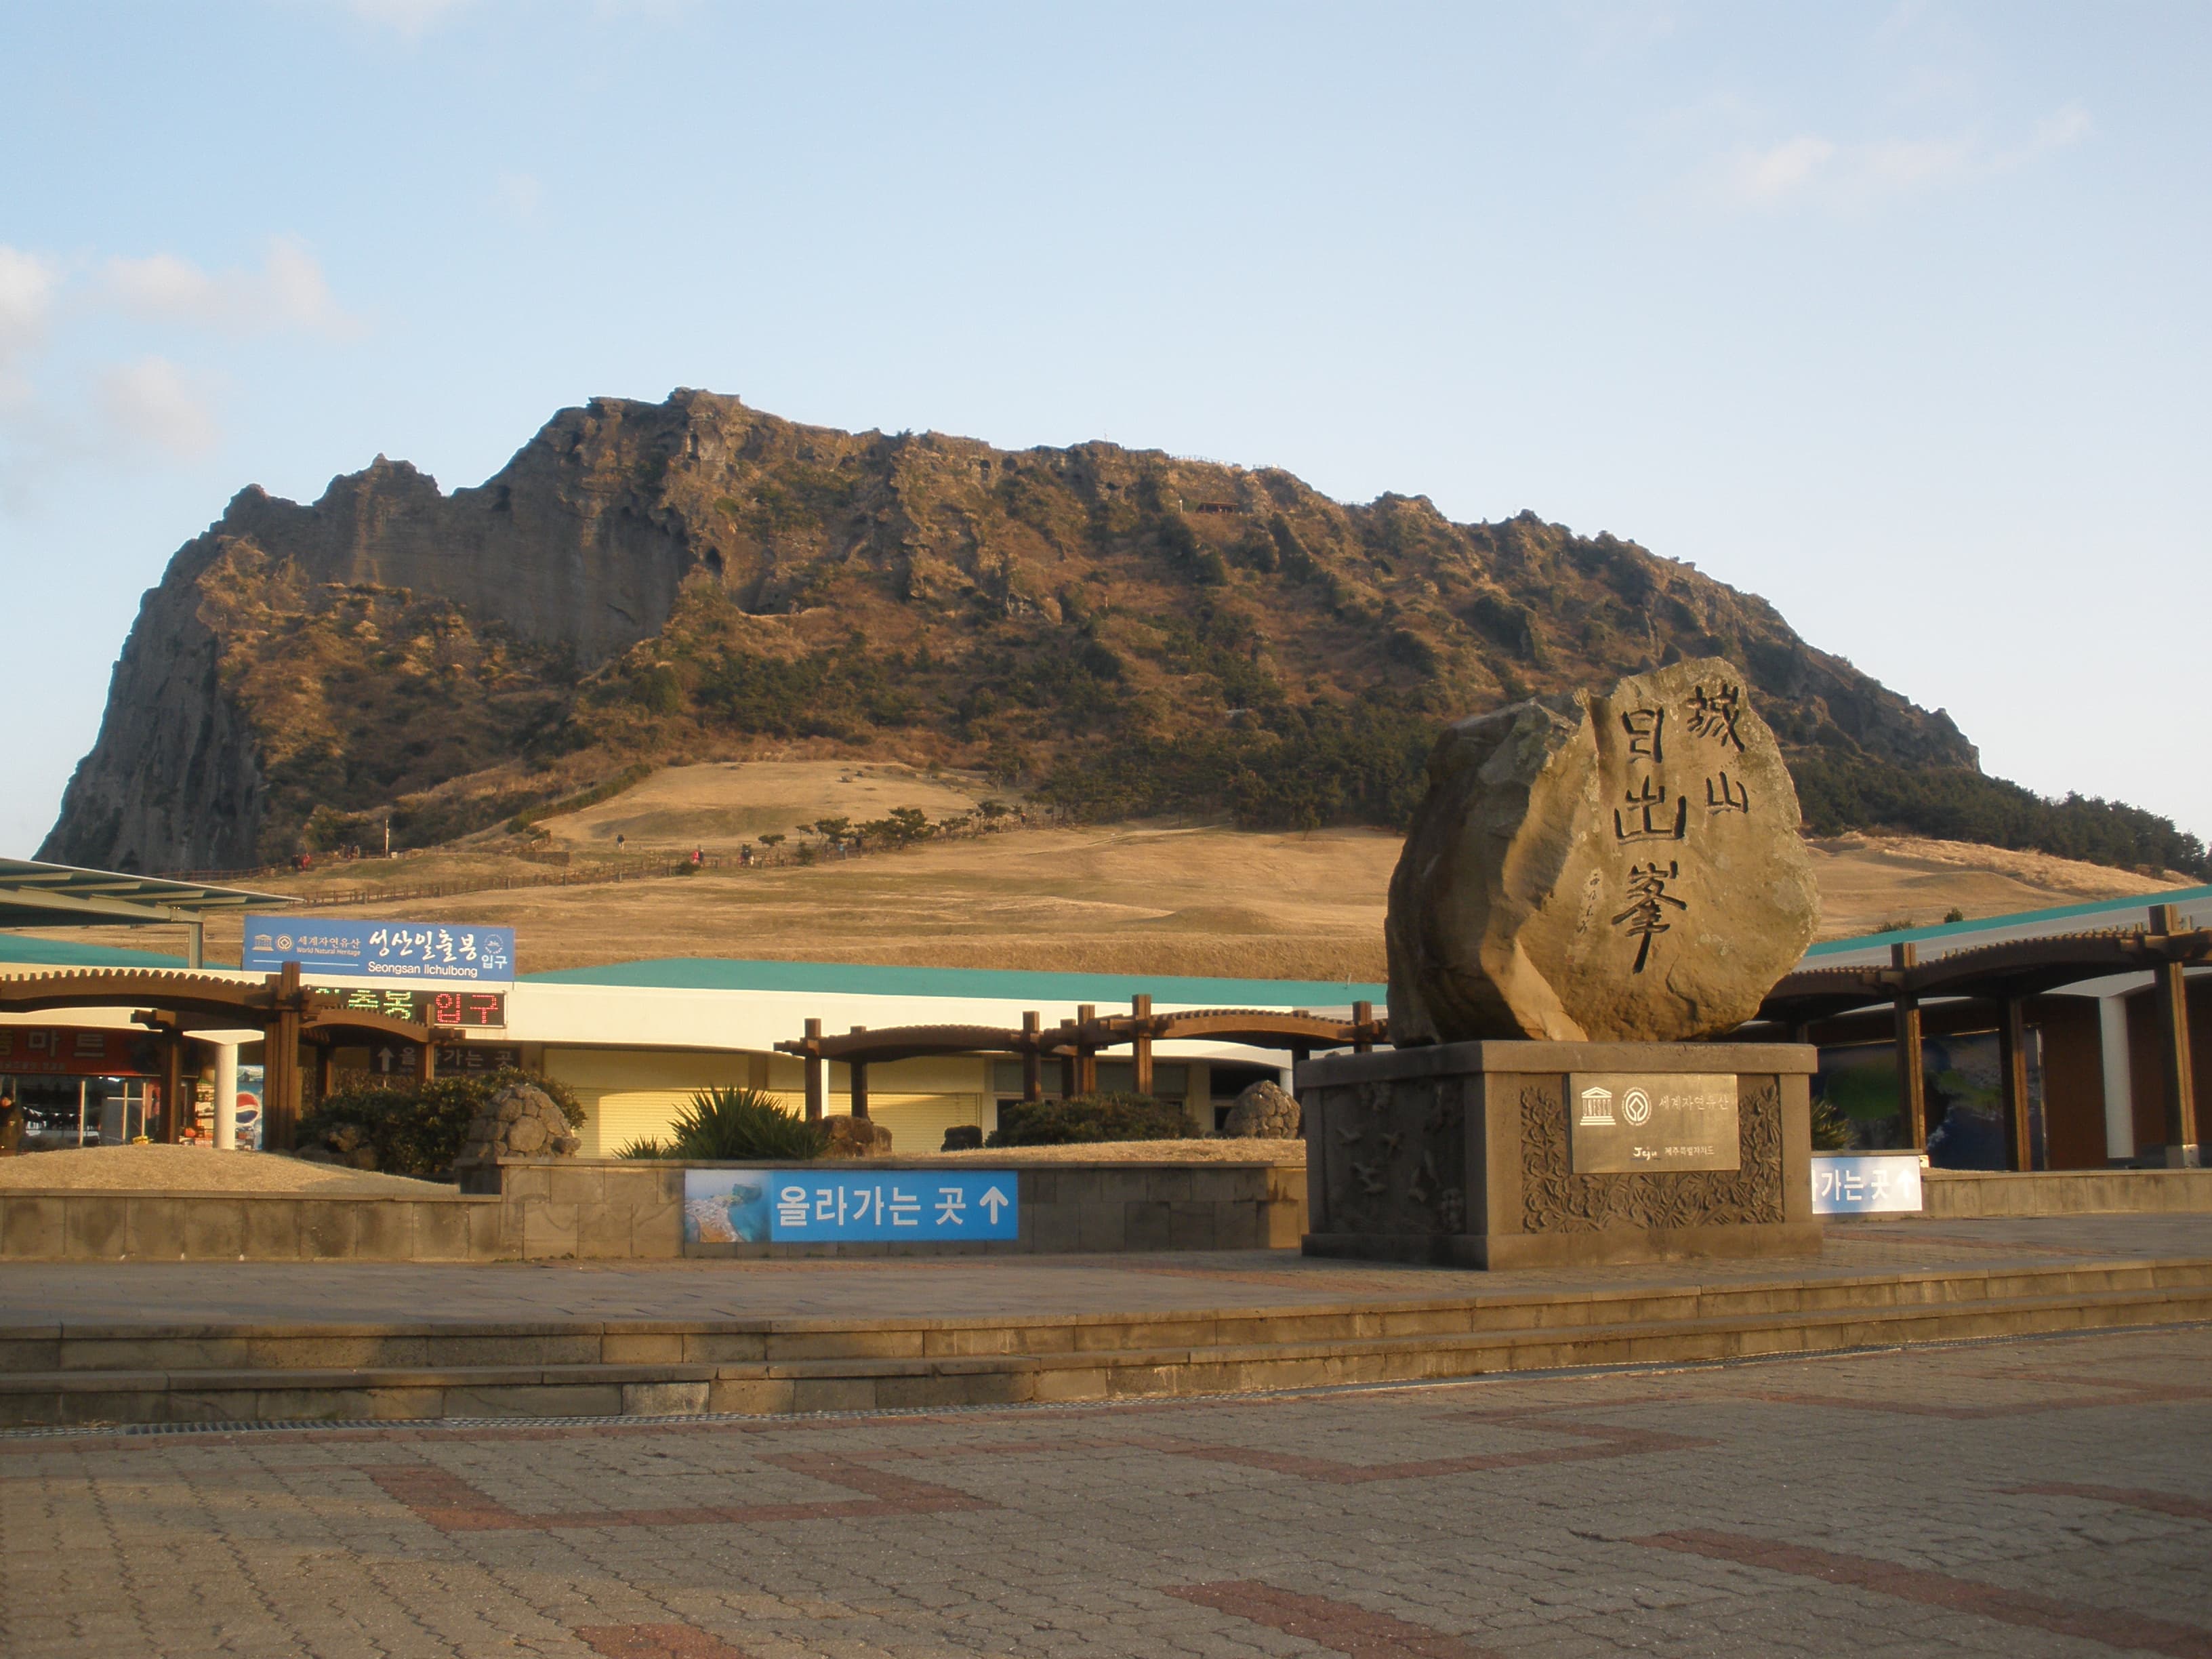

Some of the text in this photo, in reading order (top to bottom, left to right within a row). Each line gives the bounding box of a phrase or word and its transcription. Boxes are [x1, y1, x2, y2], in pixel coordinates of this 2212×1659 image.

[298, 936, 361, 949] 세계자연유산
[369, 928, 478, 963] 성산일출봉
[336, 949, 361, 957] Heritage
[368, 961, 478, 978] Seongsan Ilchulbong
[481, 955, 508, 969] 입구
[436, 993, 498, 1024] 입구
[1658, 1094, 1729, 1111] 세계자연유산
[1633, 1146, 1658, 1161] Jeju
[1871, 1170, 1889, 1200] 곳
[777, 1185, 966, 1227] 올라가는 곳
